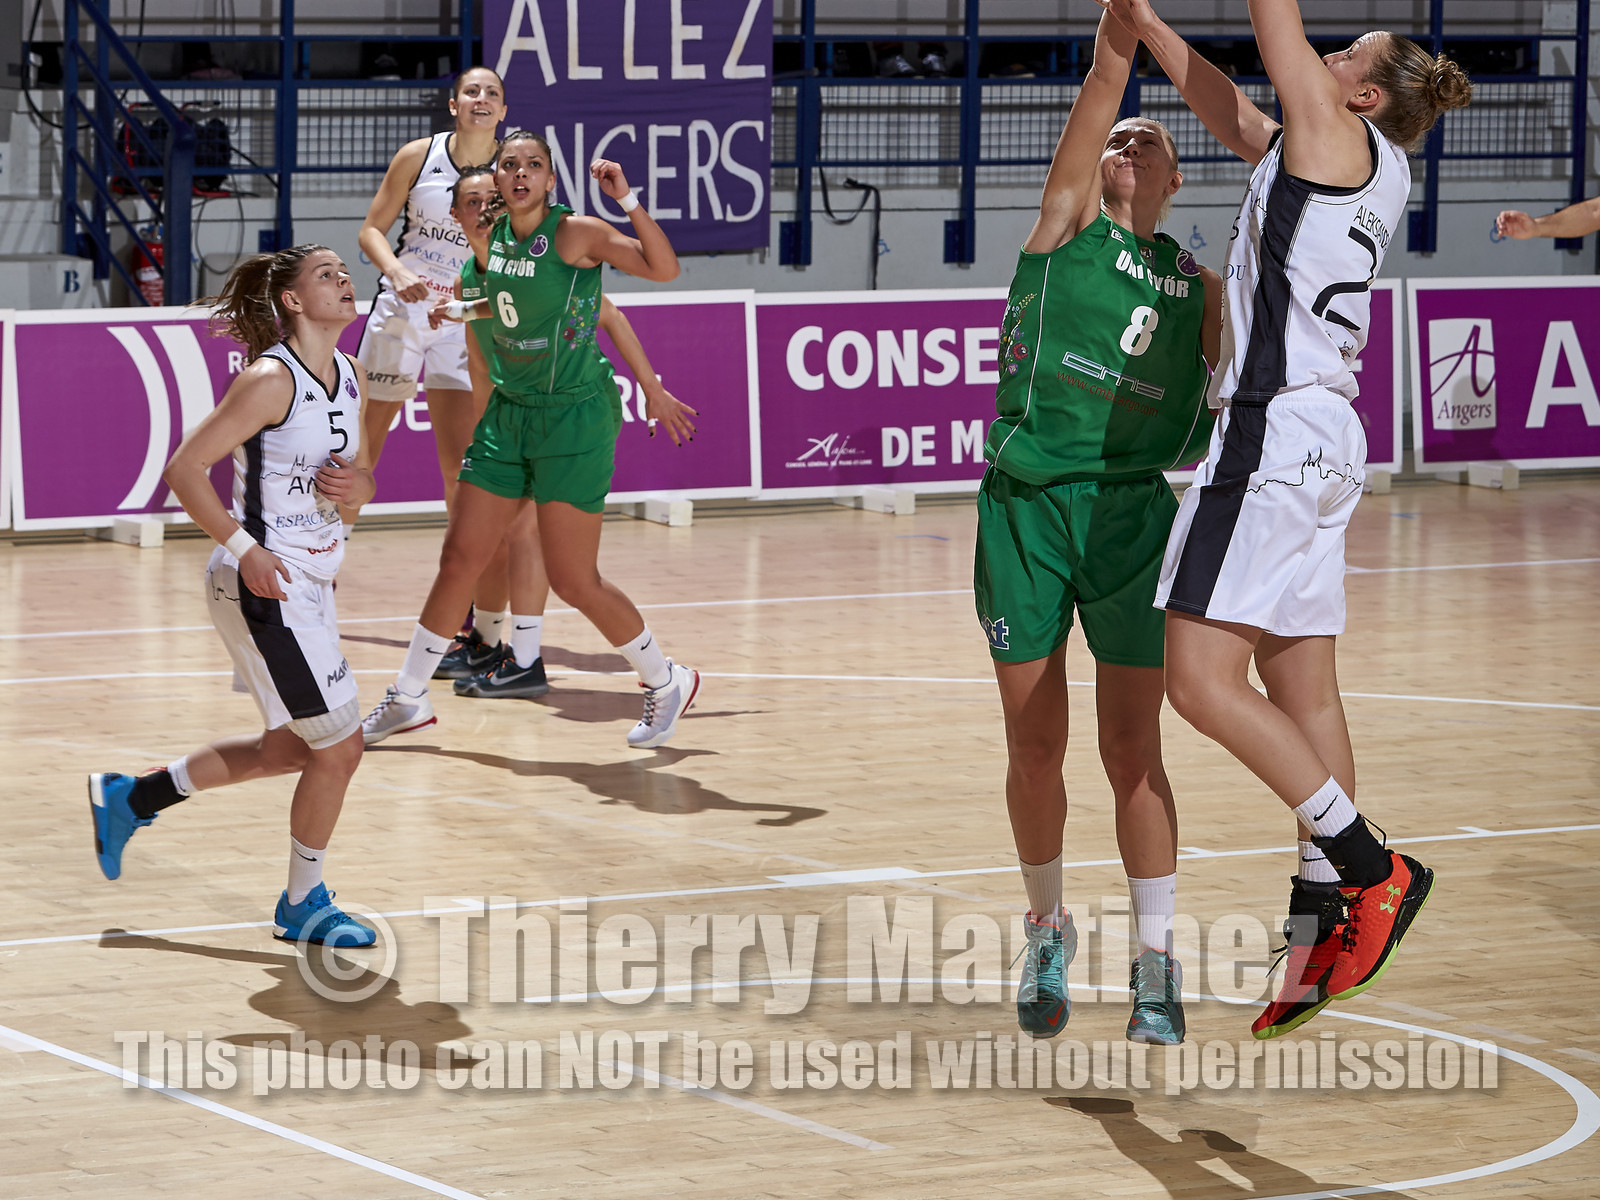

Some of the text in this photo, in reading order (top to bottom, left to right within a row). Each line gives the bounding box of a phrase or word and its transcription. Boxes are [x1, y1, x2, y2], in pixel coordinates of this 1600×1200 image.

[504, 120, 764, 223] NGERS
[418, 226, 470, 249] ANGE
[63, 269, 80, 293] B
[1311, 225, 1377, 331] 2
[496, 290, 519, 328] 6
[1119, 305, 1159, 356] 8
[366, 370, 399, 385] ARTY
[786, 325, 1000, 391] CONSE
[327, 410, 349, 453] 5
[1437, 401, 1492, 425] Angers
[881, 425, 936, 467] DE
